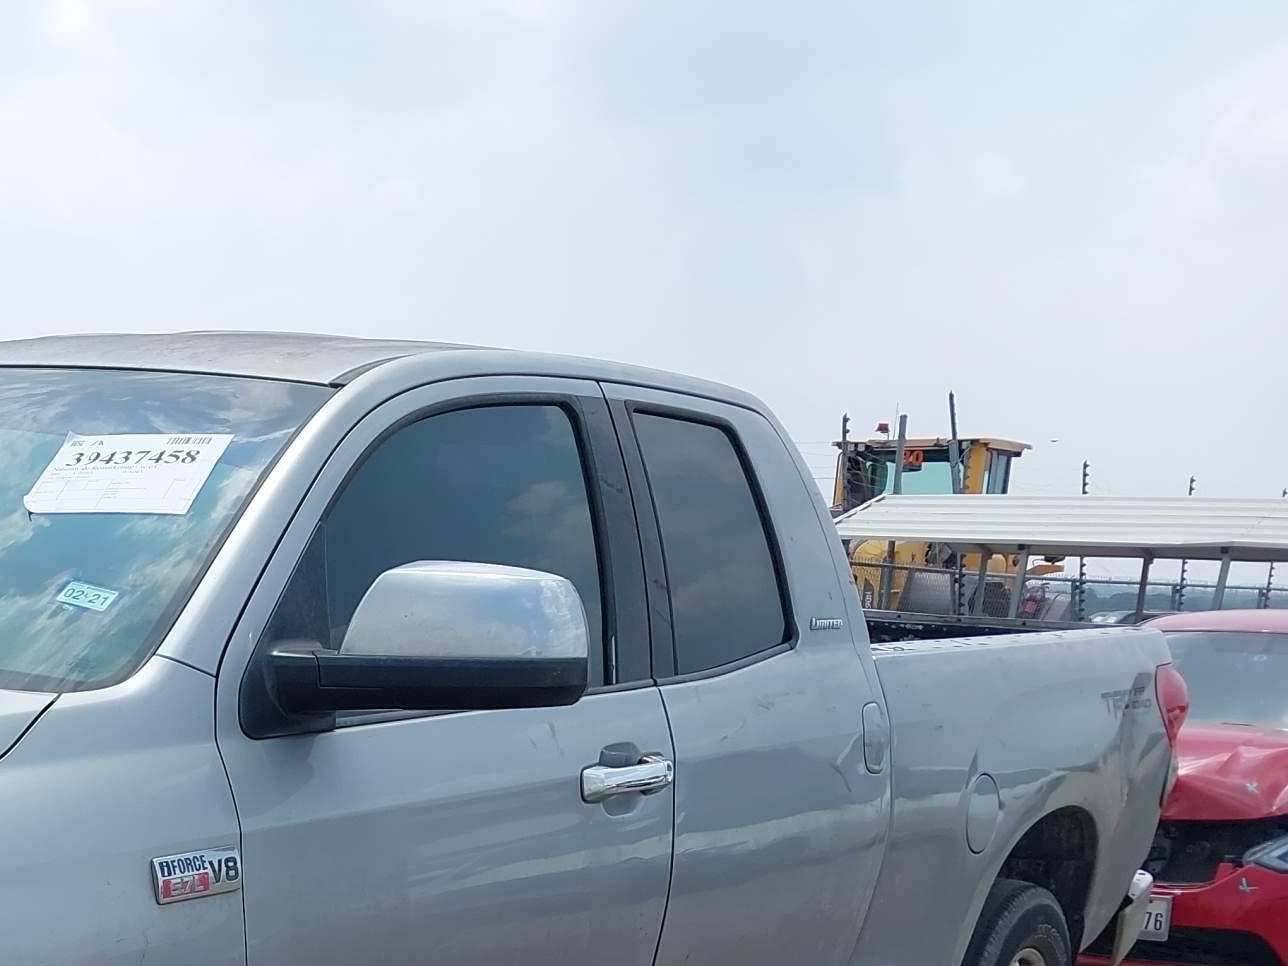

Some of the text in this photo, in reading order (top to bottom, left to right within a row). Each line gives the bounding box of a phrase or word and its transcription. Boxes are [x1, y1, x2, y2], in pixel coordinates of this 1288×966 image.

[66, 450, 200, 466] 39437458
[208, 856, 240, 884] V8
[1144, 911, 1163, 931] 76
